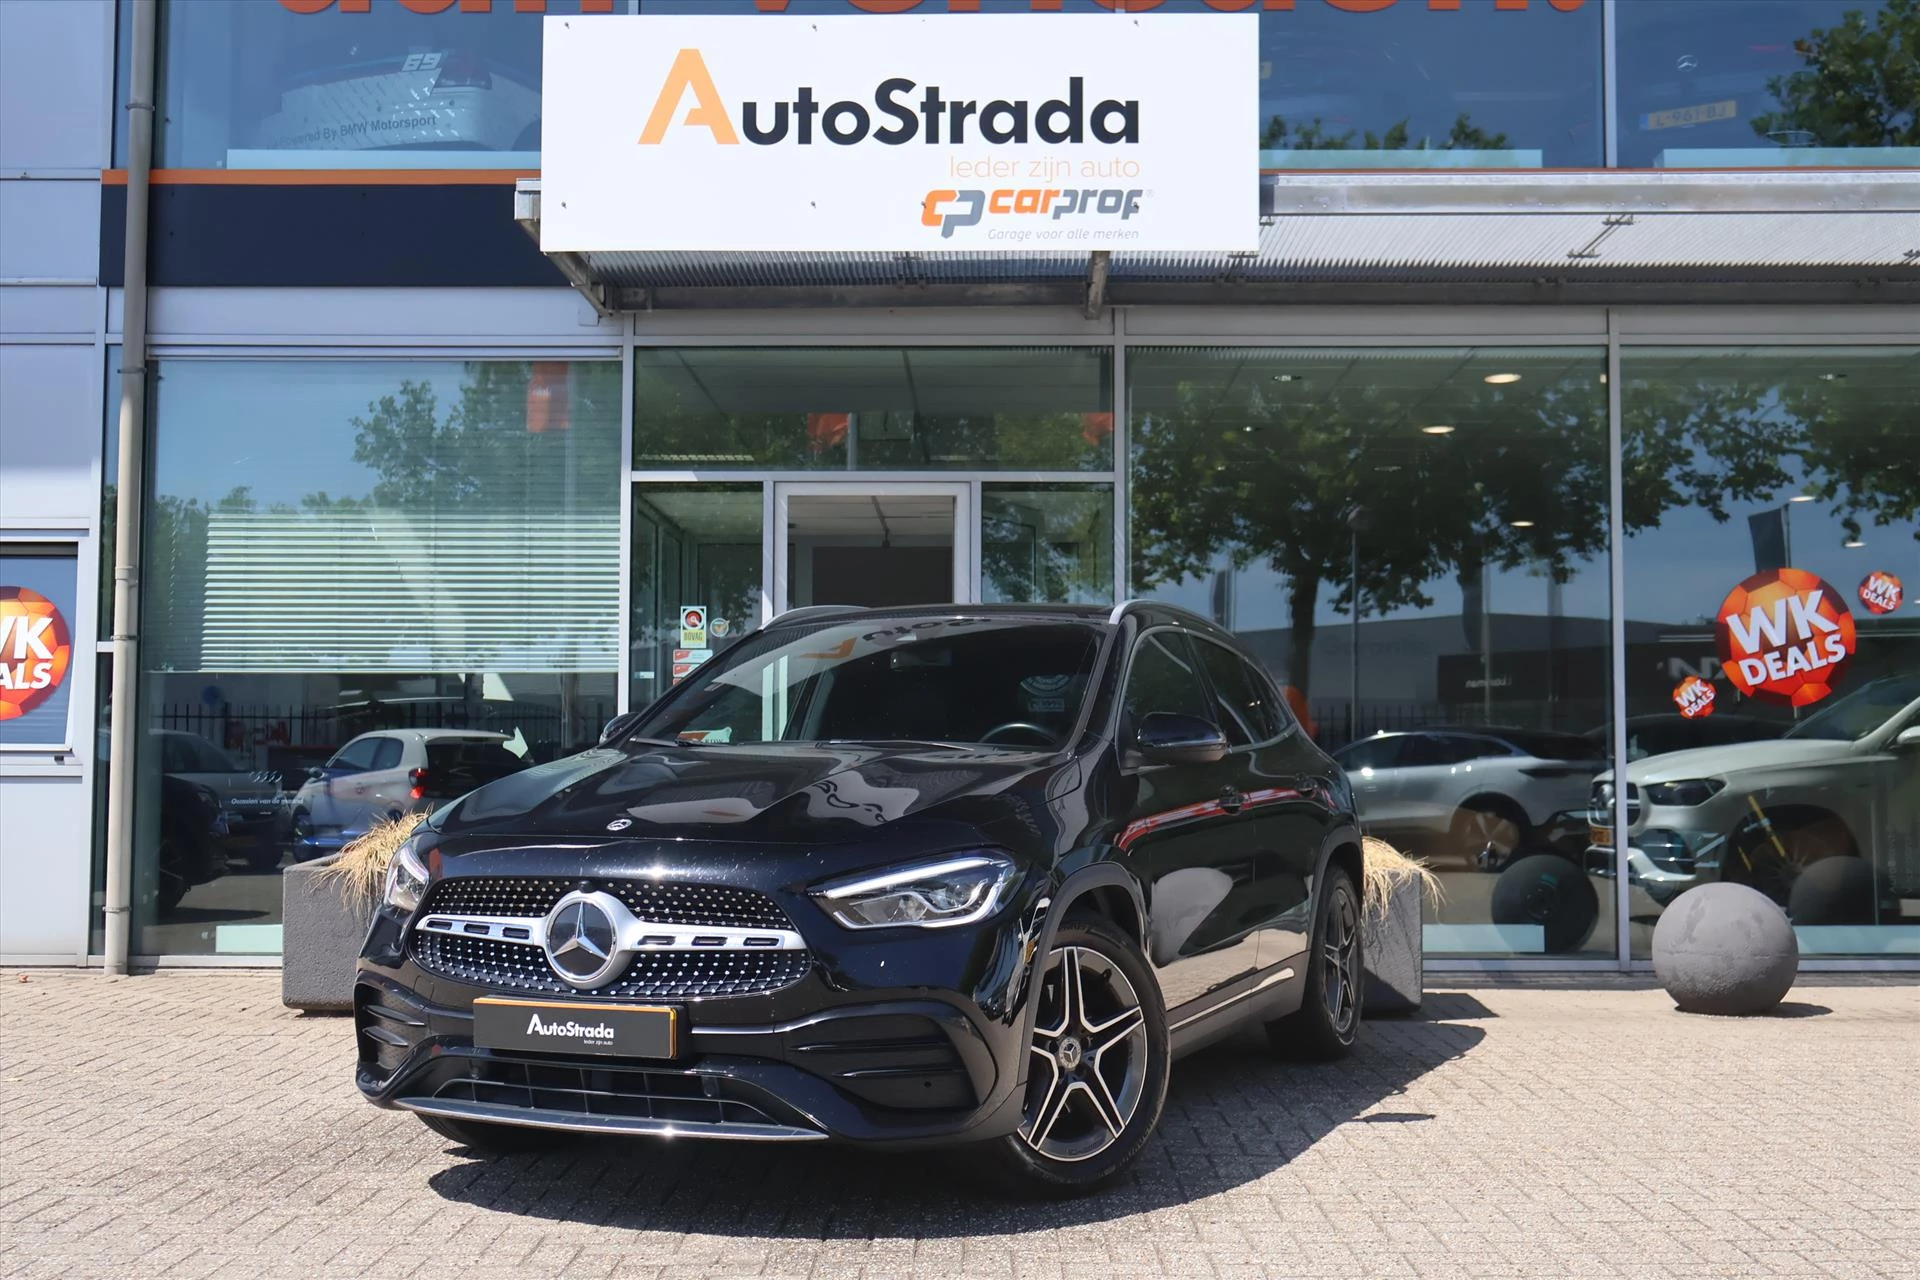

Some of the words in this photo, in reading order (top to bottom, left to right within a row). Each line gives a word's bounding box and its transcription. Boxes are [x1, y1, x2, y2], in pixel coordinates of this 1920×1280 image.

[637, 48, 1139, 145] AutoStrada
[323, 127, 337, 140] By
[340, 121, 368, 137] BMW
[371, 115, 436, 133] Motorsport
[950, 156, 1019, 178] Ieder
[1028, 157, 1071, 182] zijn
[1081, 159, 1140, 178] auto
[988, 228, 1032, 242] Garage
[1036, 230, 1063, 240] voor
[1067, 228, 1089, 240] alle
[1093, 228, 1139, 240] merken
[1862, 589, 1896, 610] DEALS
[1869, 575, 1901, 602] WK
[1725, 589, 1840, 654] WK
[1738, 634, 1846, 686] DEALS
[0, 662, 53, 690] ALS
[1675, 679, 1709, 707] WK
[1684, 689, 1715, 716] DEALS
[527, 1013, 614, 1039] AutoStrada
